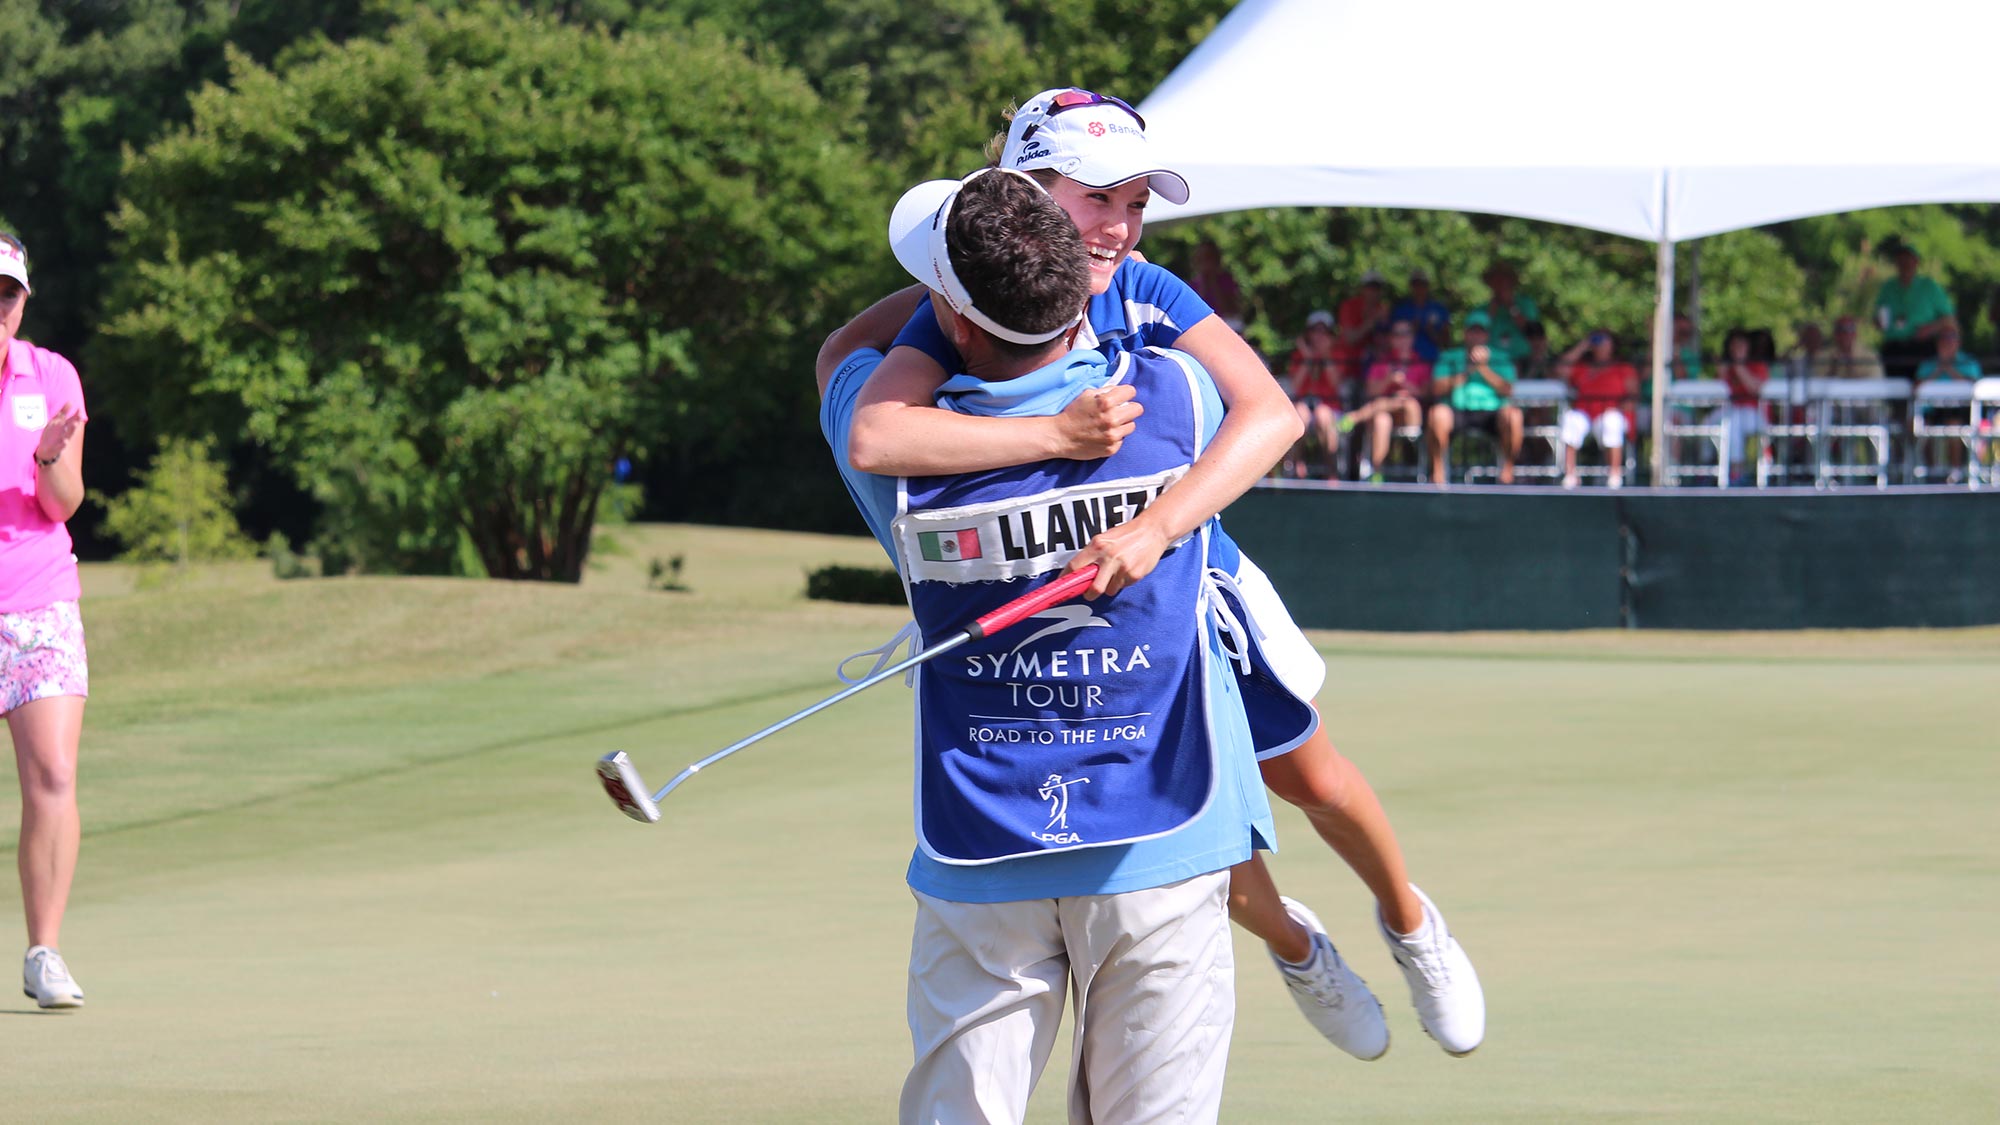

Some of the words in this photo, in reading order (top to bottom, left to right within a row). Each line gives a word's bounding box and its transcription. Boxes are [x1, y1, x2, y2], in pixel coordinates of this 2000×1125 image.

[998, 485, 1164, 561] LLANEZ
[1006, 682, 1104, 707] TOUR
[969, 727, 1021, 742] ROAD
[1028, 730, 1054, 744] TO
[1060, 729, 1096, 743] THE
[1103, 725, 1146, 741] LPGA
